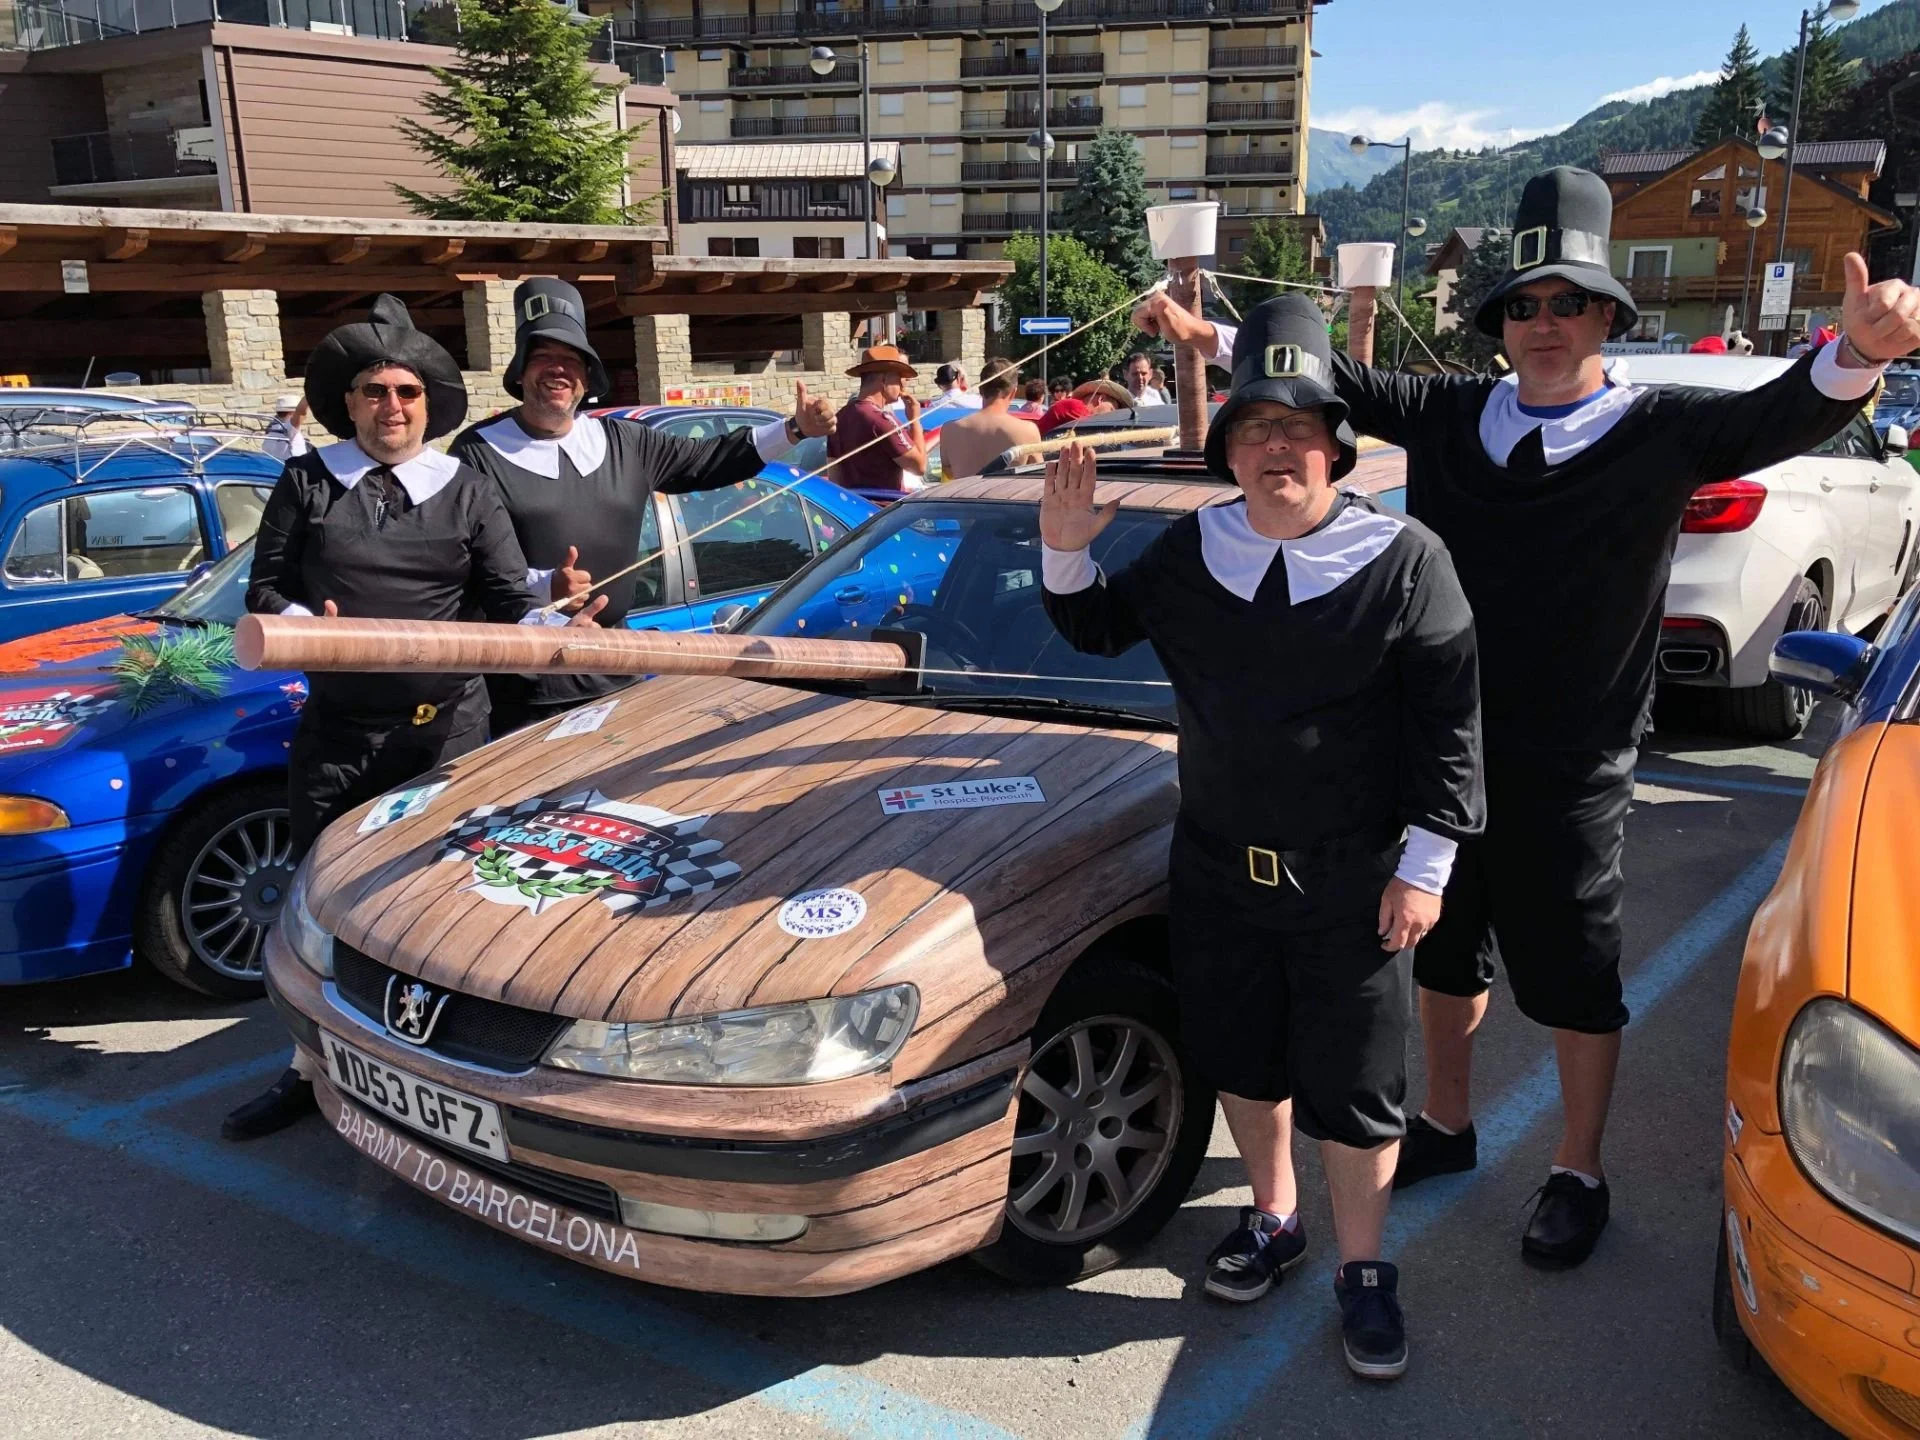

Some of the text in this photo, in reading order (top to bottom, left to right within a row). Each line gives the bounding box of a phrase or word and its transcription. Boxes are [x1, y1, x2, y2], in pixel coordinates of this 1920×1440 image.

[1775, 267, 1783, 277] P
[931, 782, 1035, 798] St Luke's
[934, 791, 1033, 806] Hospice Plymouth
[484, 826, 661, 882] Wacky Rally
[800, 907, 842, 918] MS
[331, 1041, 490, 1149] WD53 GFZ
[336, 1102, 640, 1269] BARMY TO BARCELONA
